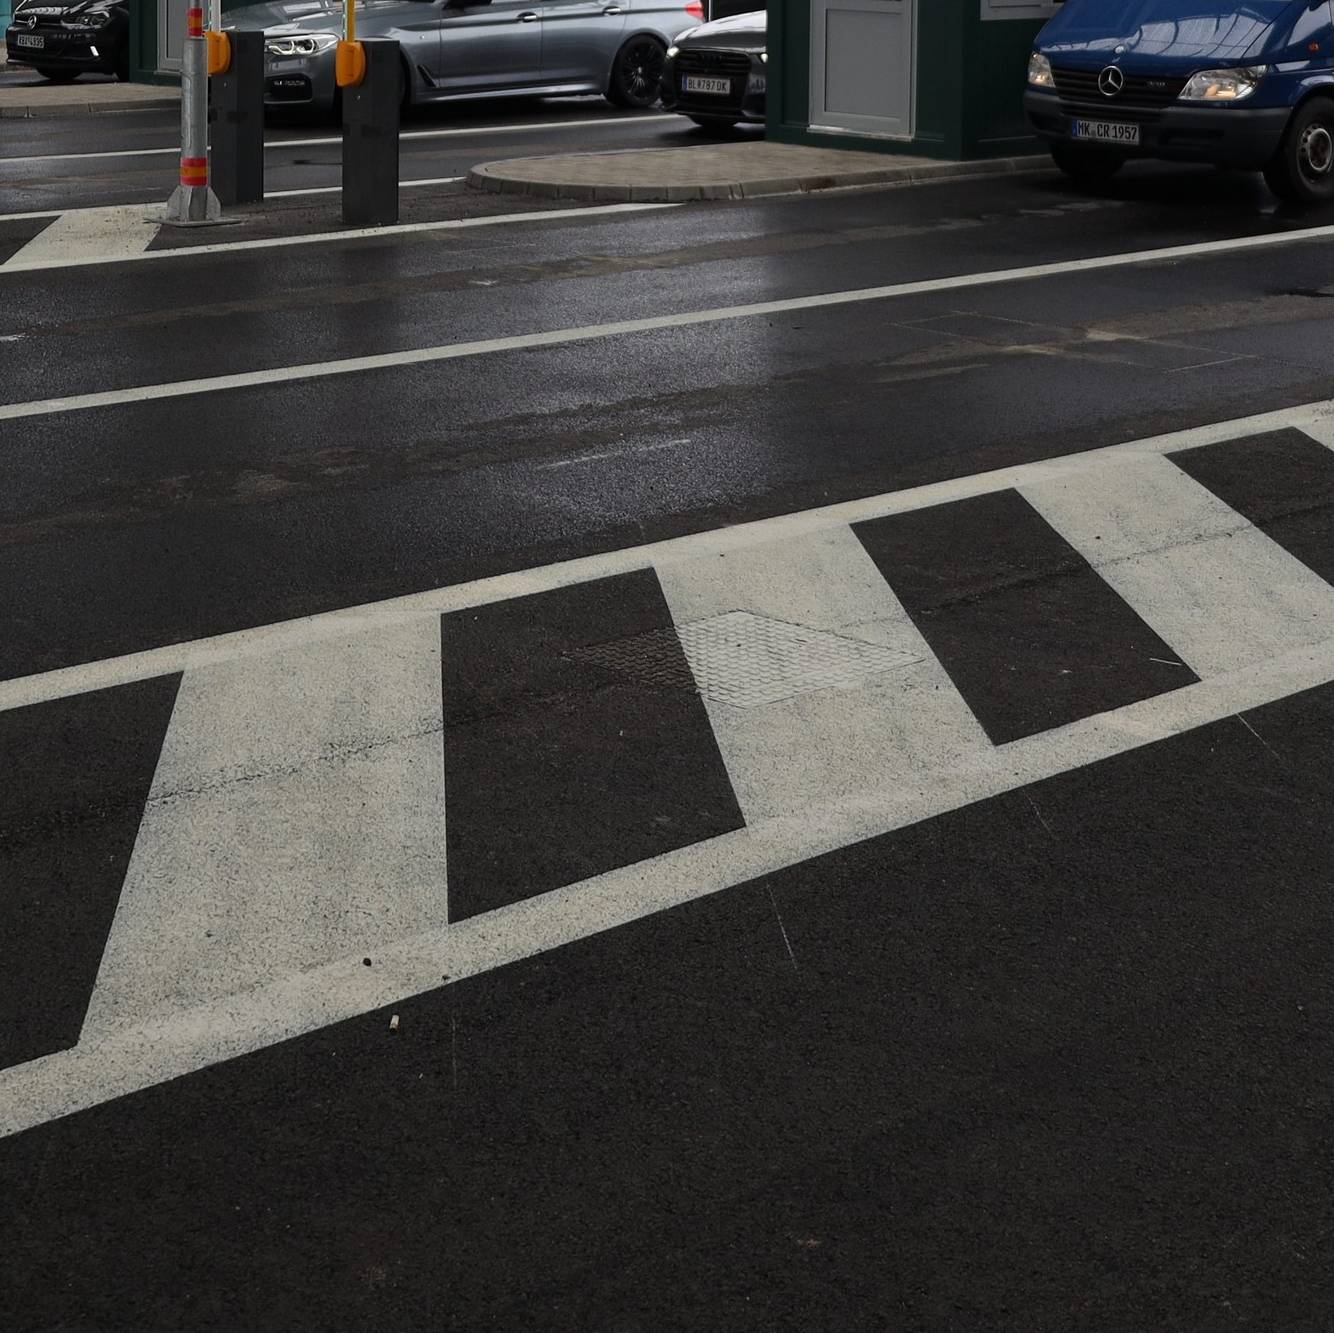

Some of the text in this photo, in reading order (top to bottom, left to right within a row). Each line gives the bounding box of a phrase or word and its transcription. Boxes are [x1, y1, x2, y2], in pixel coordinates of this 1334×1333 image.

[688, 78, 697, 90] BL
[1077, 121, 1138, 140] MK CR 1957
